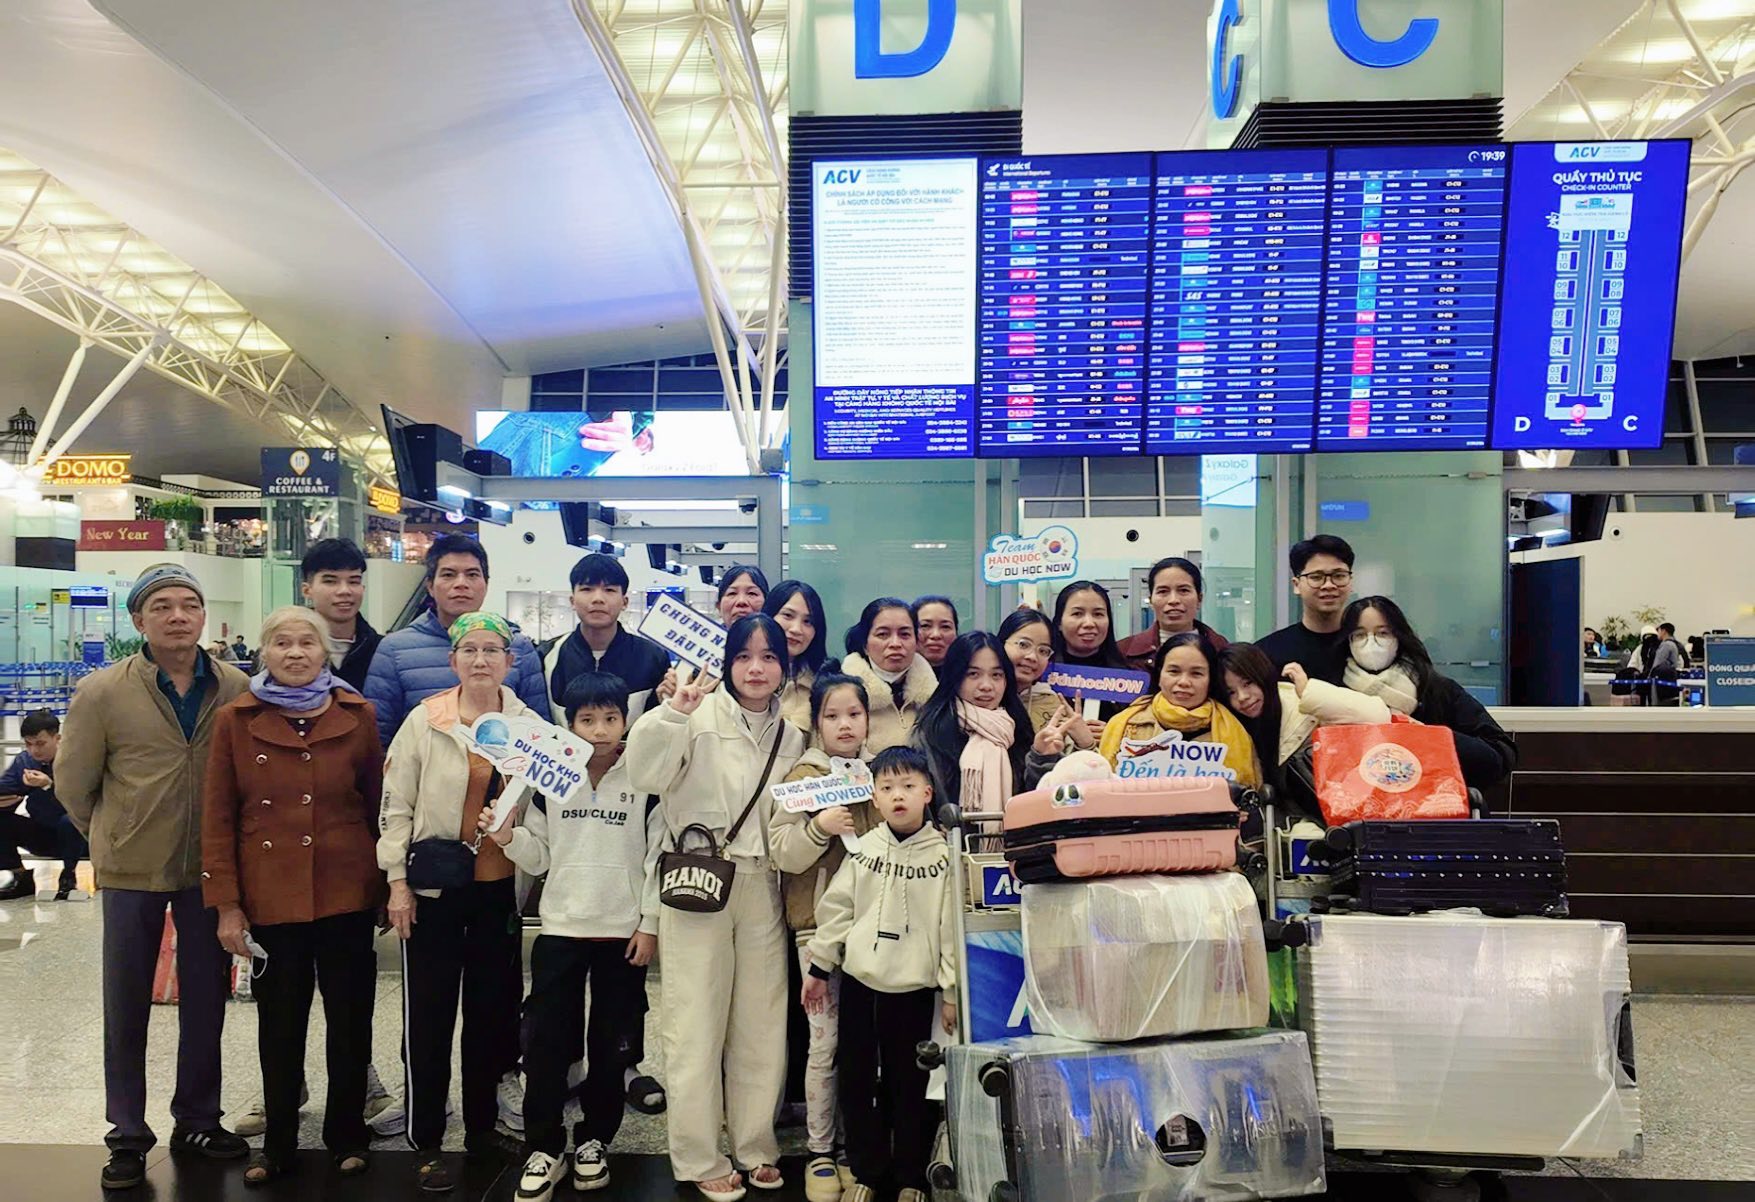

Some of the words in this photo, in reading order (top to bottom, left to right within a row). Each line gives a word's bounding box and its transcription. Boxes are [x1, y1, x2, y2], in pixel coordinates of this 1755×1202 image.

[1480, 151, 1506, 161] 19:39
[1569, 146, 1600, 158] ACV
[823, 169, 861, 184] ACV
[1590, 168, 1616, 182] THỦ
[1618, 171, 1642, 186] TỤC
[1562, 184, 1596, 192] CHECK-IN
[1562, 232, 1570, 240] 12
[1514, 417, 1531, 432] D
[1623, 415, 1638, 431] C
[322, 450, 336, 462] 4F
[57, 460, 125, 476] DOMO
[276, 477, 312, 485] COFFEE
[316, 477, 323, 485] &
[269, 485, 330, 494] RESTAURANT
[86, 528, 113, 540] New
[118, 528, 149, 540] Year
[997, 540, 1036, 553] Team
[1004, 568, 1018, 576] DU
[1046, 563, 1071, 572] NOW
[514, 739, 532, 753] DU
[1170, 744, 1223, 762] NOW
[1120, 759, 1159, 778] Đến
[526, 761, 572, 798] NOW
[661, 867, 724, 901] HANOI
